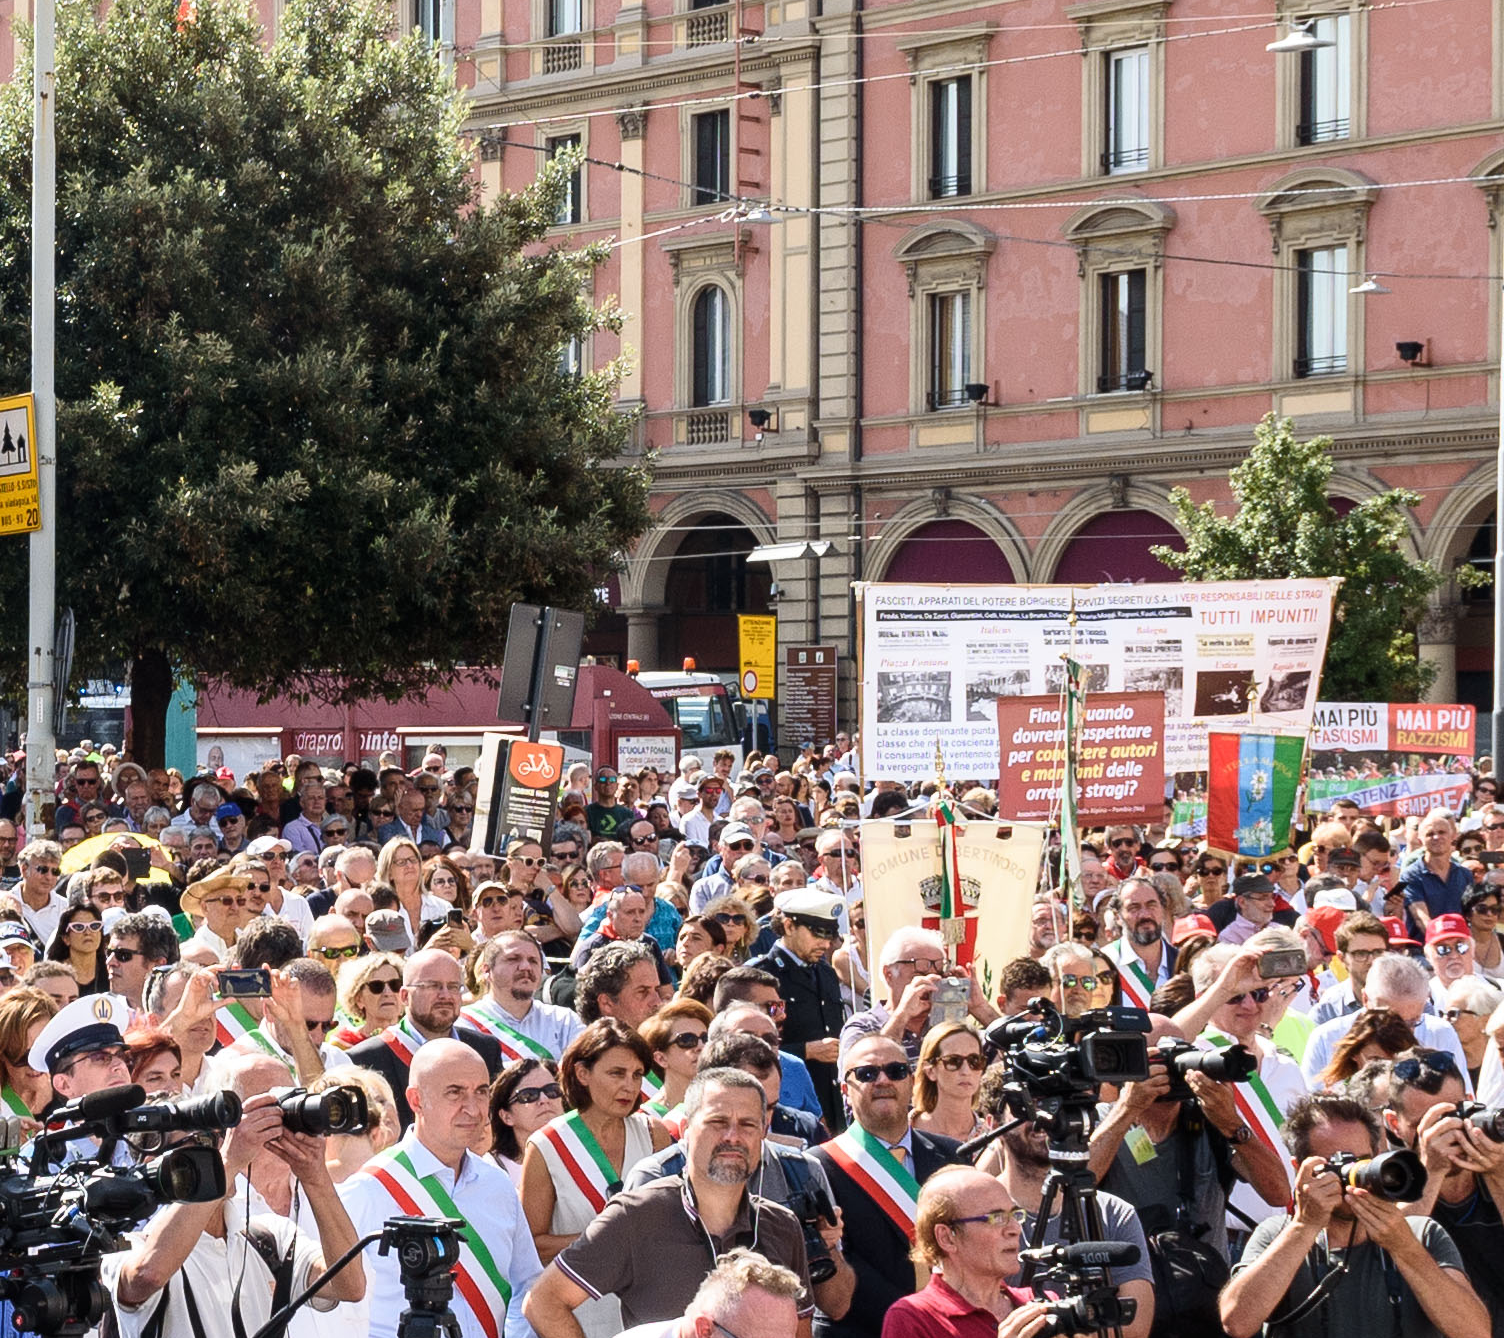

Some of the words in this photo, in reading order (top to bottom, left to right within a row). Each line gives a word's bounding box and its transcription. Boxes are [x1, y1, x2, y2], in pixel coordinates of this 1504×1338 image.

[26, 508, 38, 526] 20
[917, 596, 961, 606] APPARATI
[963, 597, 980, 606] DEL
[982, 597, 1017, 607] POTERE
[1108, 595, 1143, 605] SEGRETI
[1181, 593, 1199, 603] VERI
[1200, 591, 1263, 602] RESPONSABILI
[1264, 590, 1292, 600] DELLE
[1294, 590, 1323, 599] STRAGI
[1200, 610, 1241, 625] TUTTI
[1250, 609, 1318, 624] IMPUNITI!
[1029, 708, 1060, 723] Fino
[1083, 704, 1134, 722] uando
[1312, 710, 1343, 727] MAI
[1348, 706, 1378, 727] PIÙ
[1396, 710, 1431, 730] MAI
[1437, 705, 1471, 730] PIÙ
[877, 728, 888, 736] La
[890, 728, 920, 736] classe
[922, 727, 969, 736] dominante
[972, 727, 996, 737] punta
[1012, 728, 1068, 744] dovrem
[1314, 729, 1378, 744] FASCISMI
[1396, 731, 1469, 748] RAZZISMI
[877, 740, 906, 748] classe
[908, 739, 924, 747] che
[951, 739, 994, 747] coscienza
[884, 751, 931, 759] consumati
[950, 750, 991, 759] ventennio
[1008, 750, 1034, 766] per
[1110, 741, 1158, 758] autori
[877, 762, 885, 770] la
[954, 762, 970, 770] fine
[1020, 770, 1031, 782] e
[1106, 761, 1143, 778] delle
[1085, 780, 1139, 800] stragi?
[871, 847, 930, 881] COMUNE
